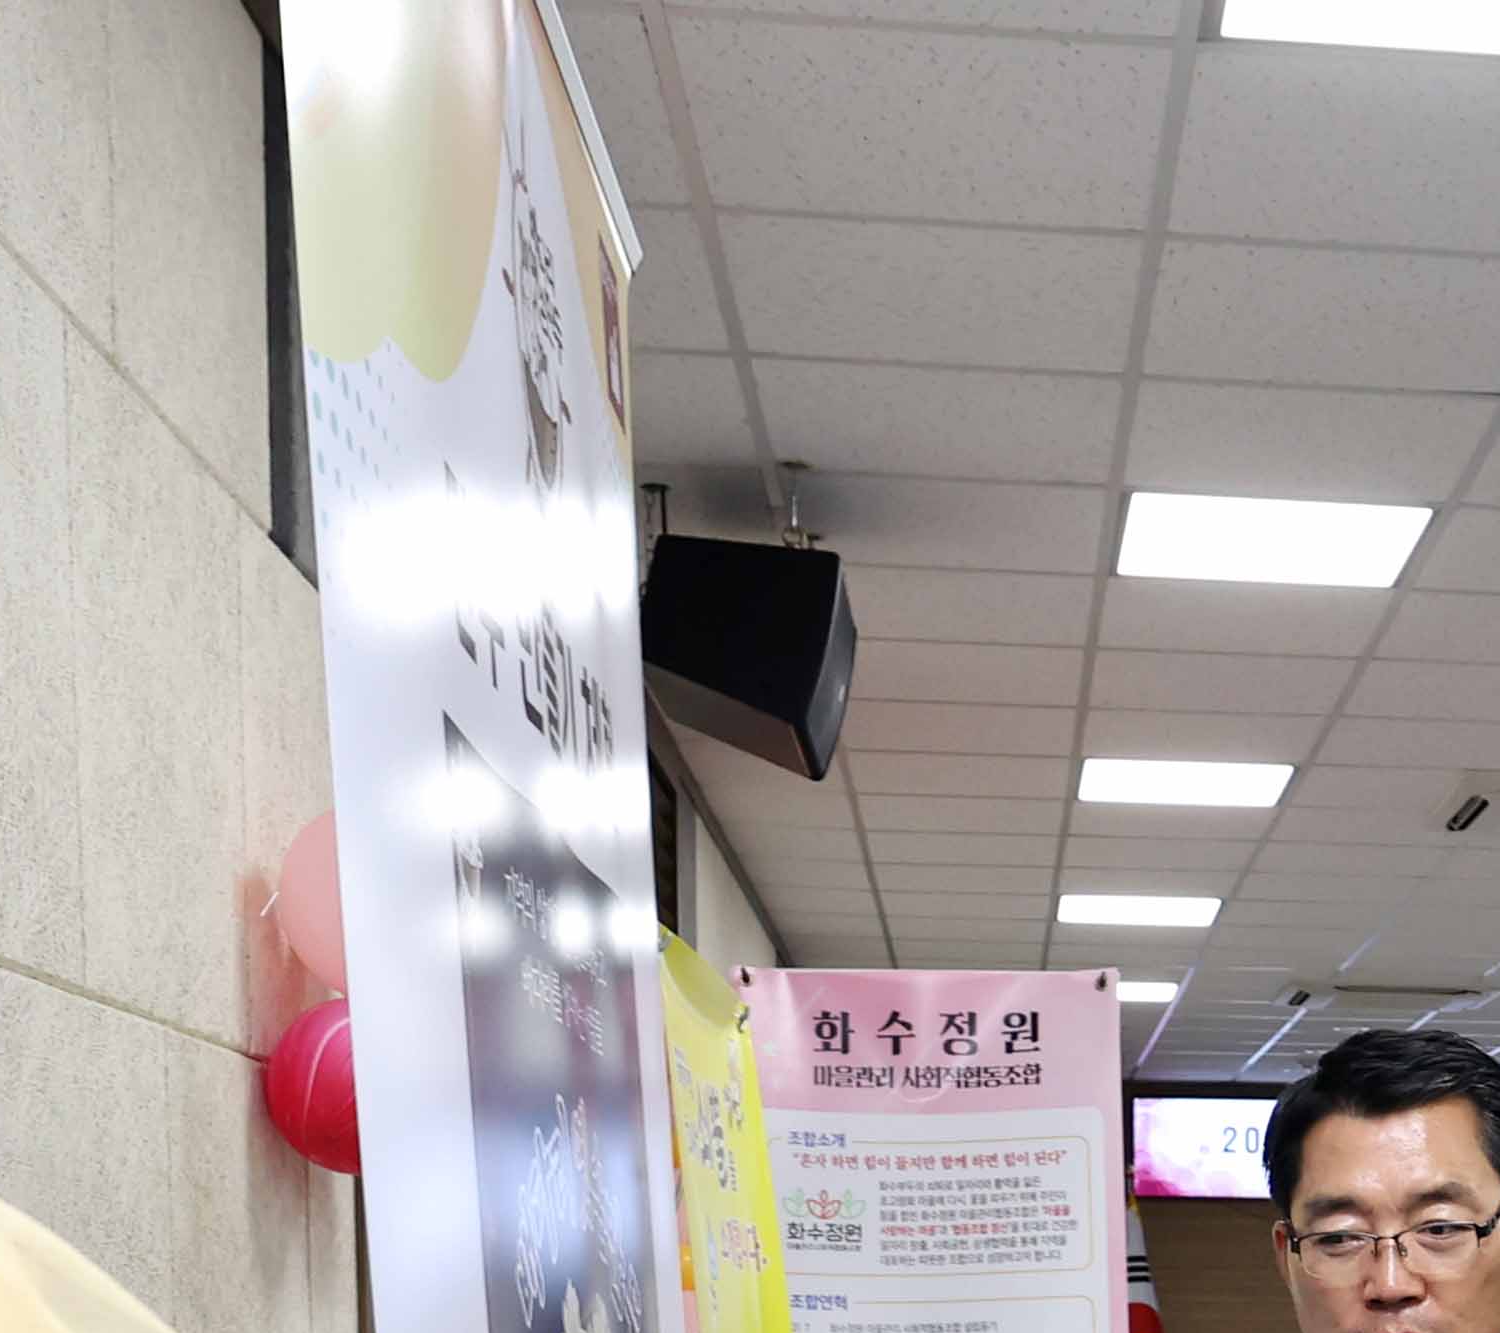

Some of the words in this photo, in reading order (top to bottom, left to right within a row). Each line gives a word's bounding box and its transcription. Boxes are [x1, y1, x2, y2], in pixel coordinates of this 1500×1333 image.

[813, 1066, 894, 1089] 마을관리
[902, 1063, 1042, 1089] 사회적협동조합
[787, 1131, 845, 1148] 조합소개
[788, 1222, 863, 1242] 화수정원
